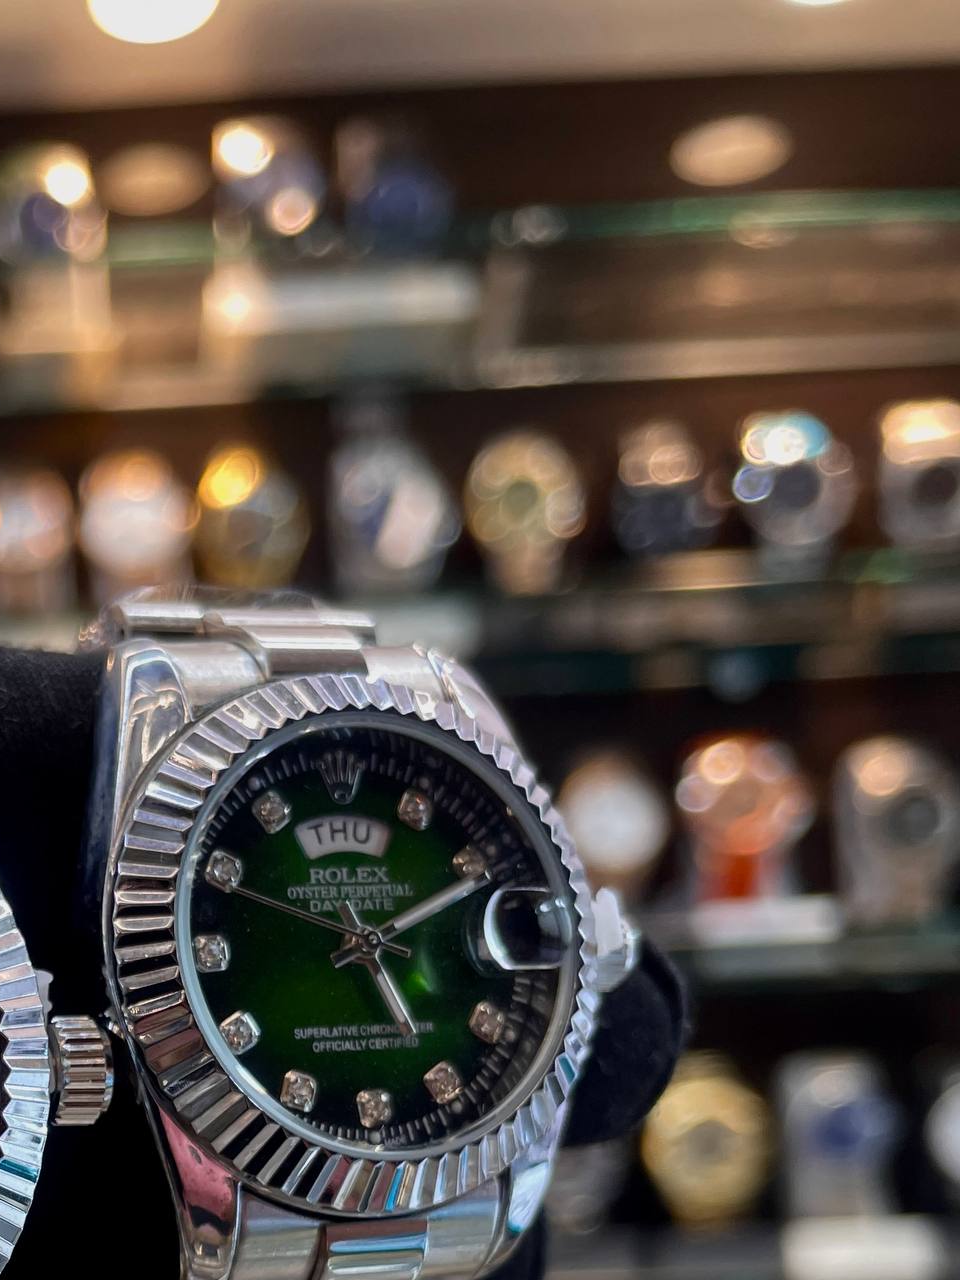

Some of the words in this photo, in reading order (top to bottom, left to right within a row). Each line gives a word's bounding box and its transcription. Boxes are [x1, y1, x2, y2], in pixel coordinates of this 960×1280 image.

[308, 821, 371, 845] THU
[309, 867, 389, 884] ROLEX
[287, 885, 338, 899] OYSTER
[340, 884, 414, 898] PERPETUAL
[294, 1025, 358, 1039] SUPERLATIVE
[360, 1022, 433, 1036] CHRONOTER
[313, 1040, 367, 1053] OFFICIALLY
[368, 1037, 419, 1049] CERTIFIED
